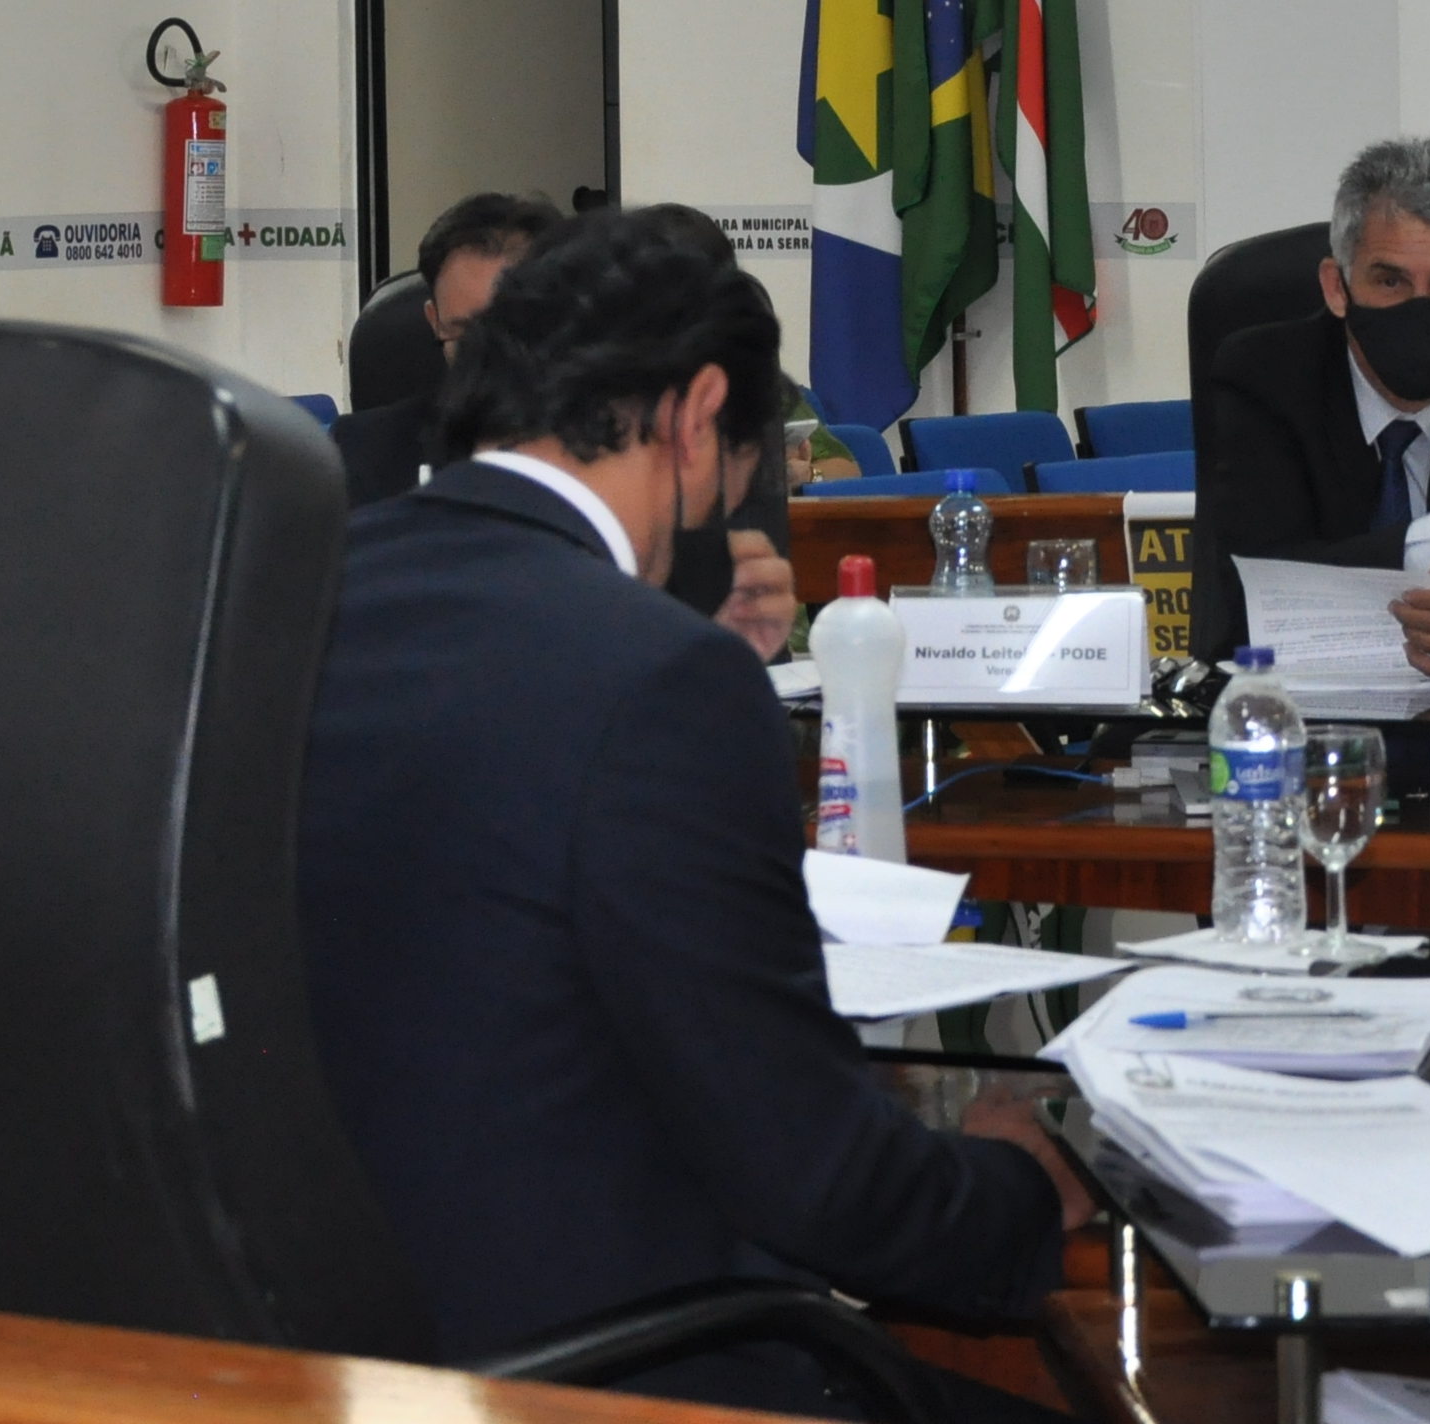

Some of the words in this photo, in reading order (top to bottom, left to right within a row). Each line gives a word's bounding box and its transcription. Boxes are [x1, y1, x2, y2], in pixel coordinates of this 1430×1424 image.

[65, 222, 142, 242] OUVIDORIA
[742, 218, 810, 231] MUNICIPAL
[1122, 208, 1169, 241] 40
[259, 222, 346, 248] CIDADÃ
[757, 238, 773, 250] DA
[66, 245, 91, 261] 0800
[93, 244, 115, 260] 642
[117, 242, 143, 259] 4010
[1139, 528, 1190, 562] AT
[1154, 625, 1189, 652] SE
[915, 646, 976, 660] Nivaldo
[1061, 648, 1107, 661] PODE
